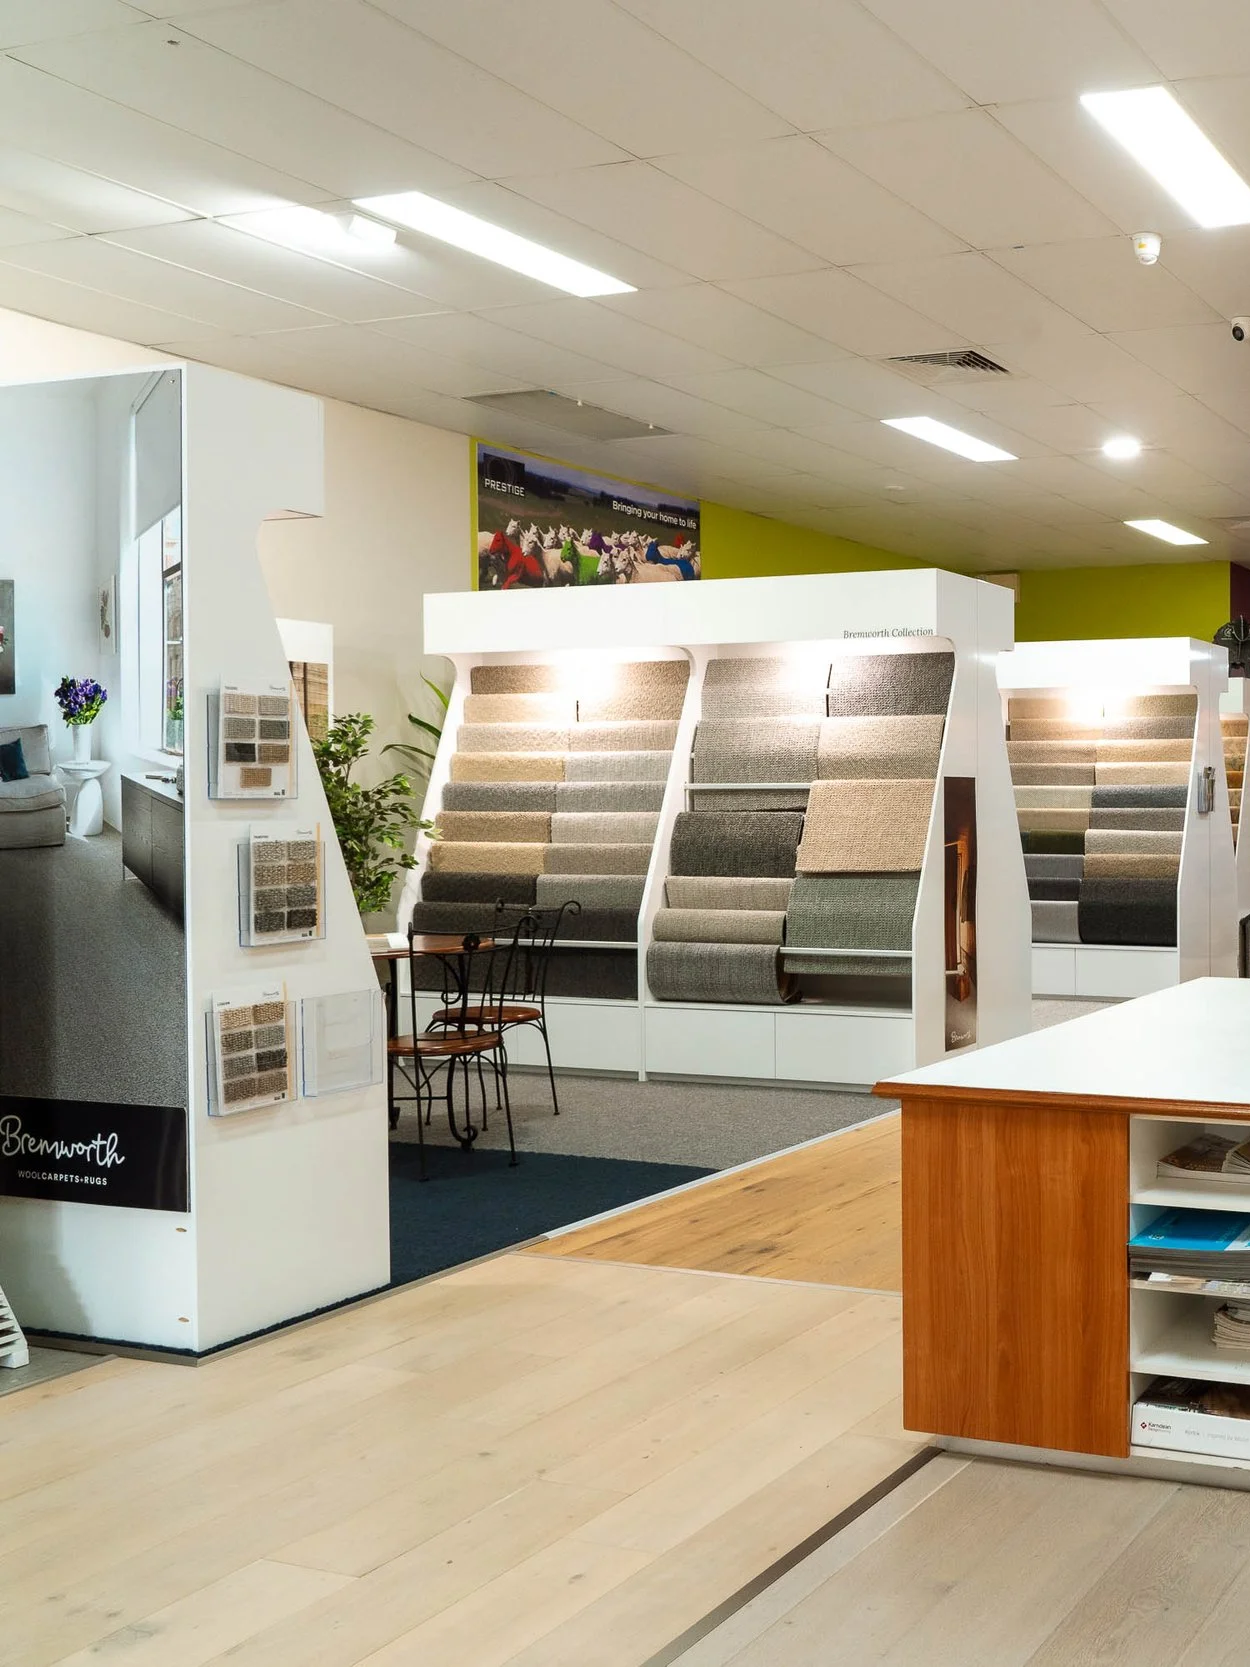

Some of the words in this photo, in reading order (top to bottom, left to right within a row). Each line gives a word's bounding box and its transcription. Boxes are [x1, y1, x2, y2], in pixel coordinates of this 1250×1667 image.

[484, 478, 525, 497] PRESTIGE
[612, 500, 642, 517] Bringing
[643, 509, 659, 519] your
[660, 512, 678, 525] home
[679, 518, 686, 527] to
[687, 519, 697, 530] life
[843, 629, 889, 639] Bremworth
[891, 627, 933, 637] Collection
[0, 1114, 126, 1168] Bremworth
